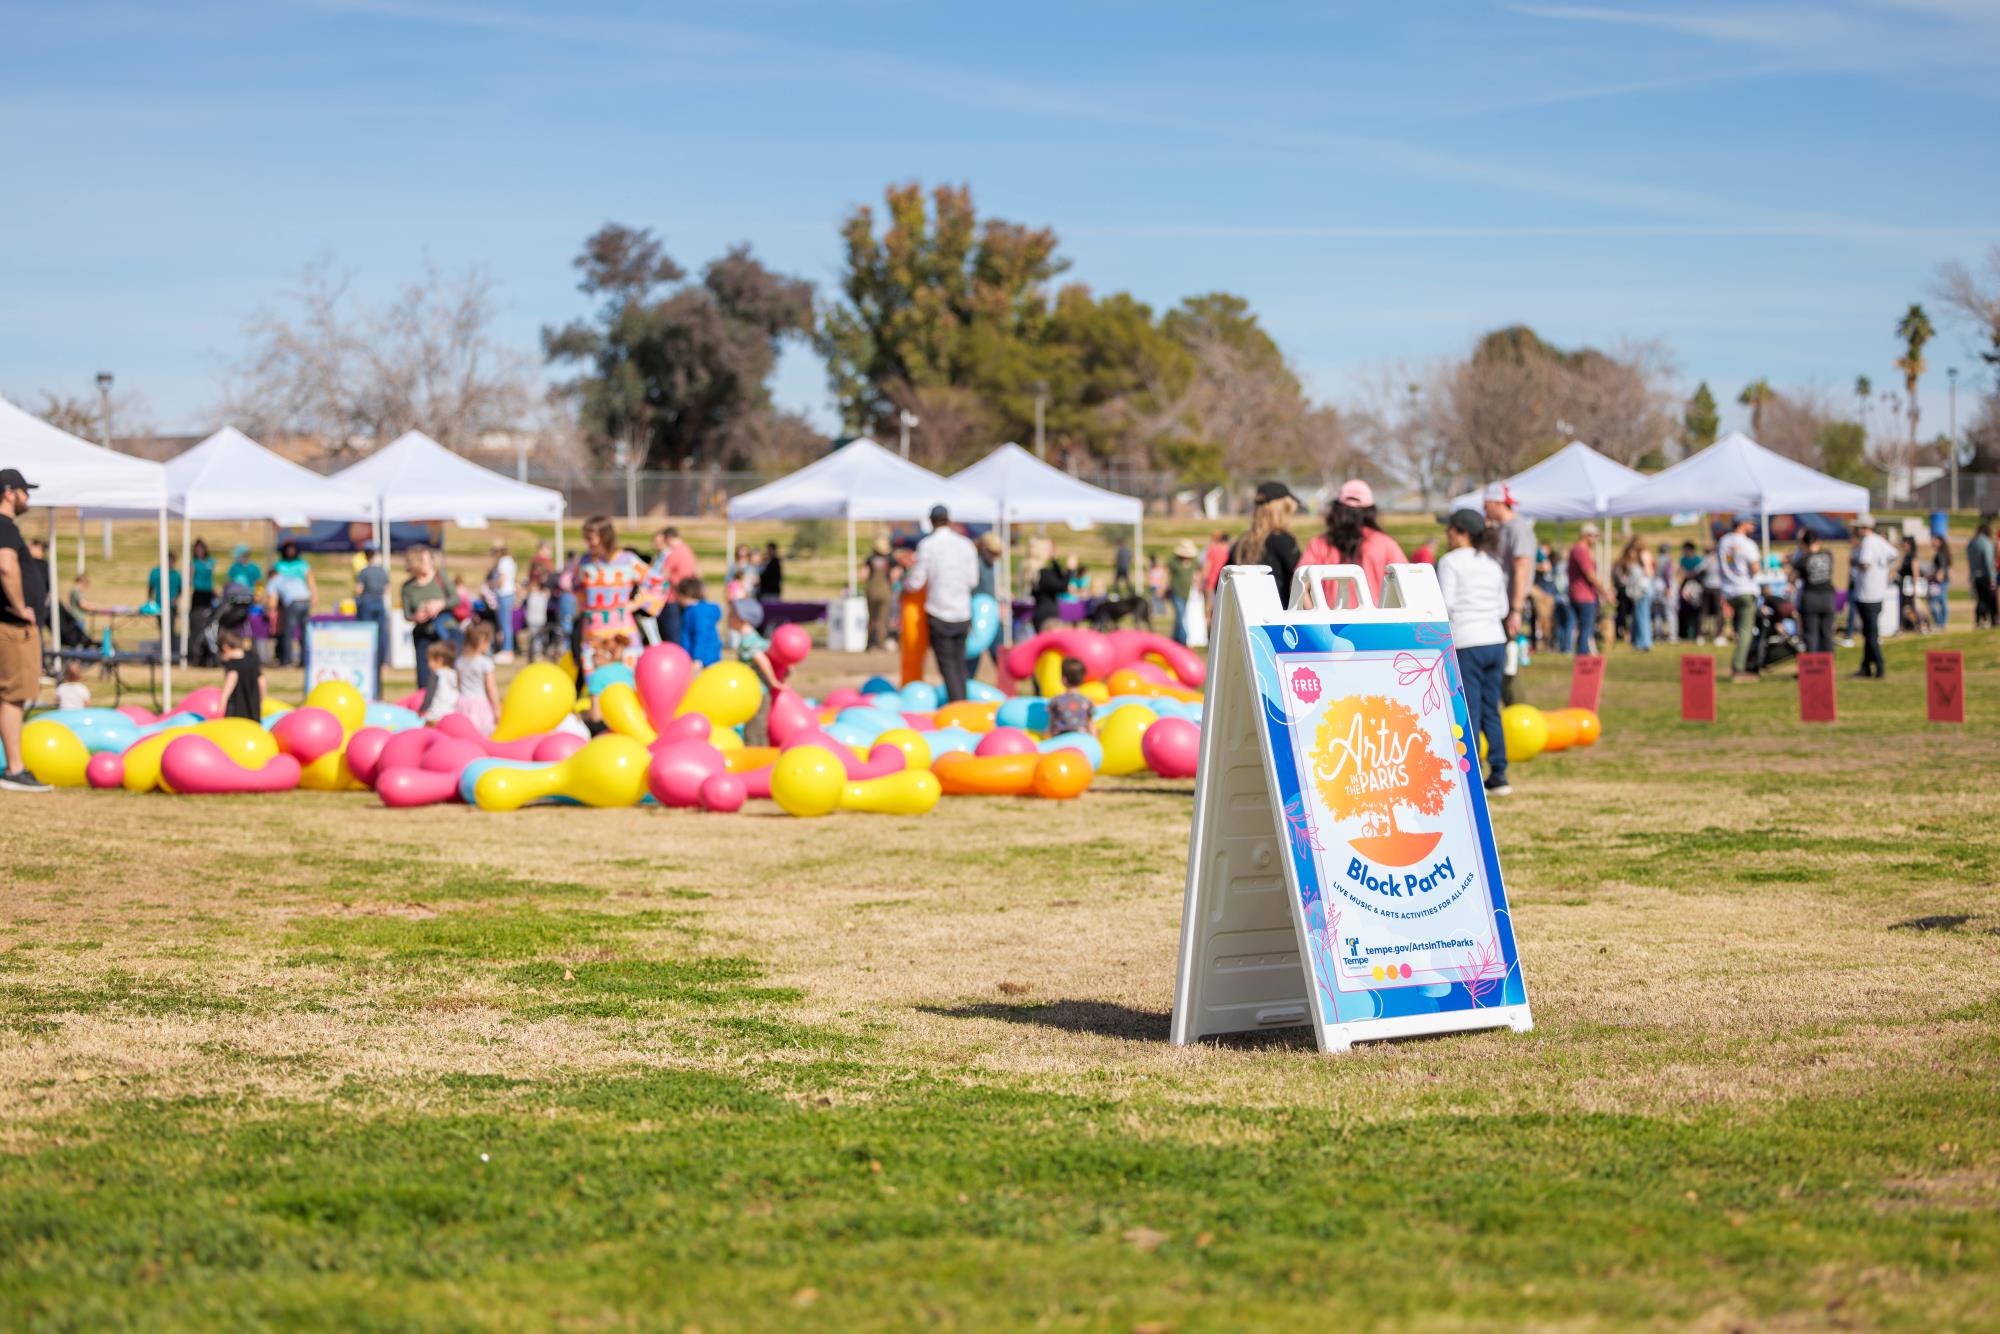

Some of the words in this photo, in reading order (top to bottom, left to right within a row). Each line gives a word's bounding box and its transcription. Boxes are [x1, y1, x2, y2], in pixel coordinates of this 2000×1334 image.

[1294, 679, 1319, 692] FREE
[1318, 712, 1422, 781] Arts
[1350, 774, 1360, 785] IN
[1360, 764, 1409, 793] PARKS
[1345, 785, 1361, 796] THE
[1347, 857, 1402, 897] Block
[1404, 856, 1455, 896] Party
[1333, 881, 1349, 898] LIVE
[1349, 894, 1372, 912] MUSIC
[1380, 909, 1400, 919] ARTS
[1401, 907, 1438, 919] ACTIVITIES
[1438, 898, 1452, 911] FOR
[1451, 889, 1463, 902] ALL
[1461, 872, 1474, 891] AGES
[1365, 938, 1474, 956] tempe.gov/ArtsInTheParks
[1343, 957, 1369, 966] Tempe
